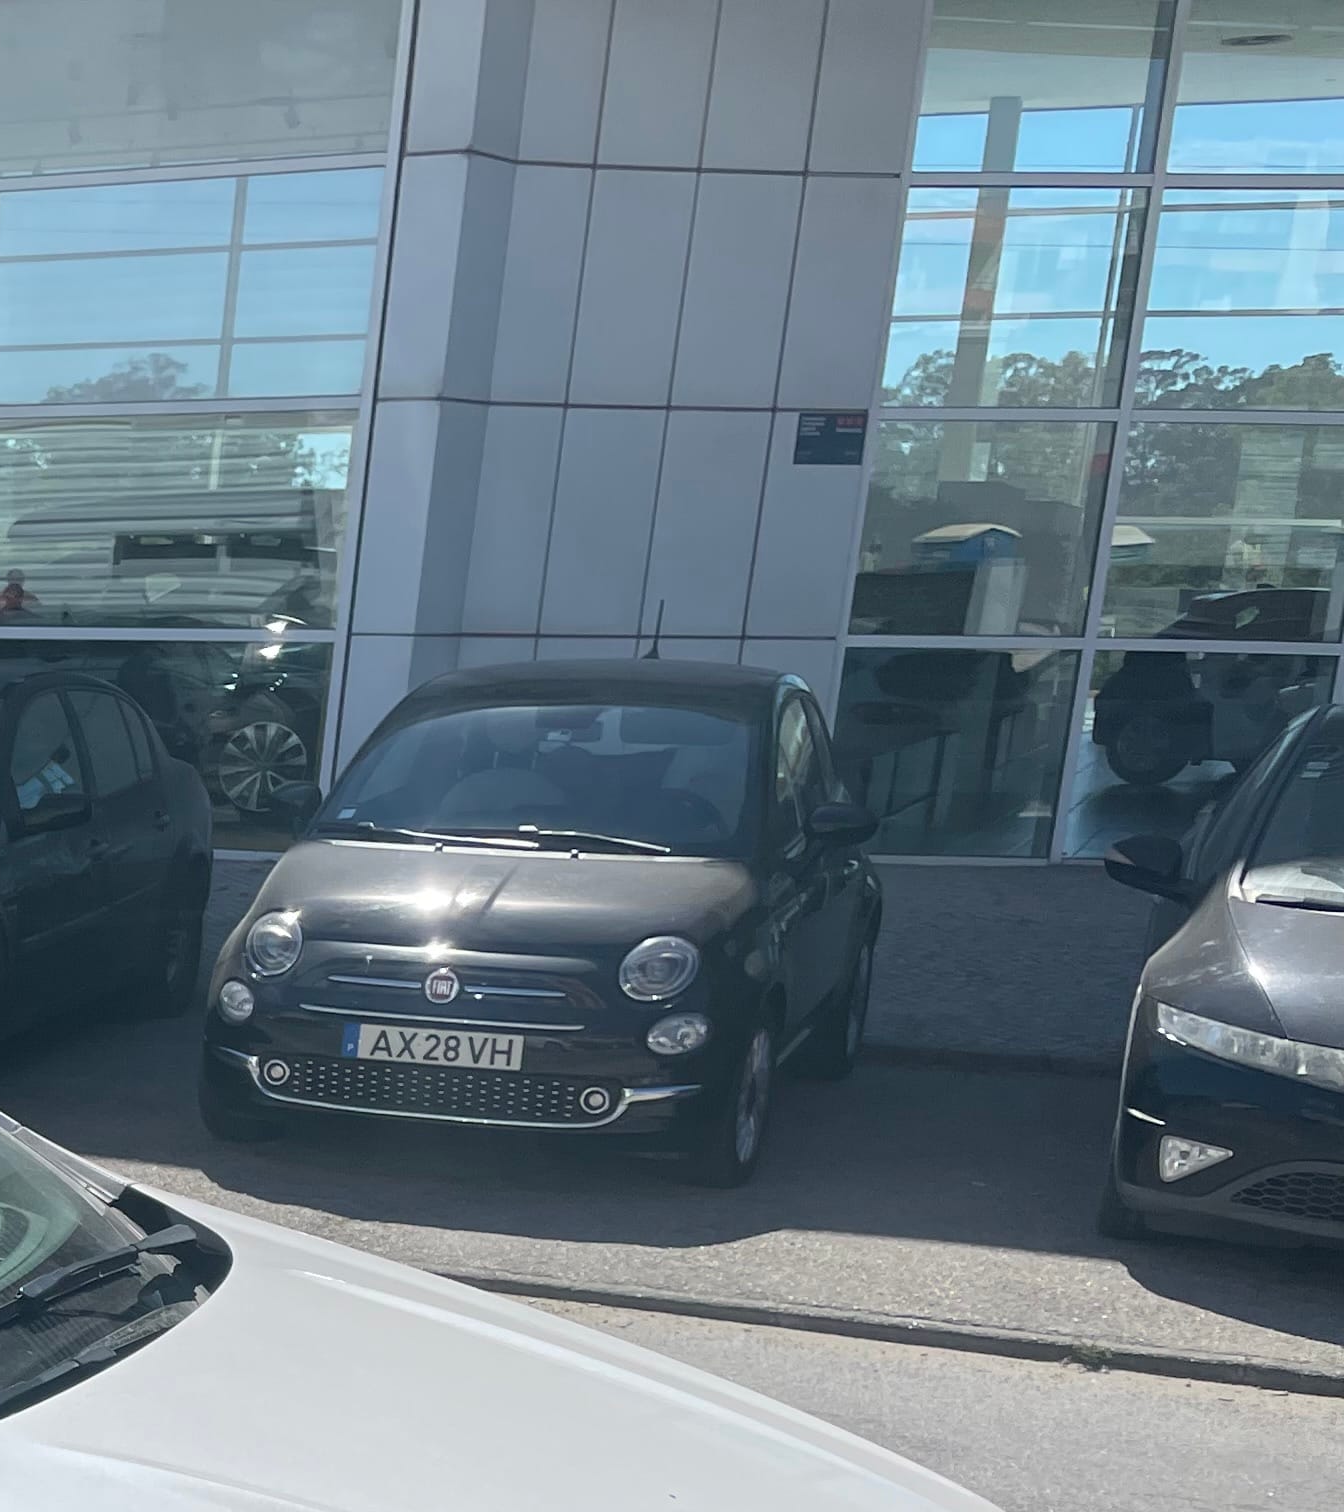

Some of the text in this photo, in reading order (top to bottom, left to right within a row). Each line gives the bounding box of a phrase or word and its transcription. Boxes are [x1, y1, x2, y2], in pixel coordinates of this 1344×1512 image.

[432, 979, 452, 996] FIAT
[369, 1029, 514, 1067] AX 28 VH
